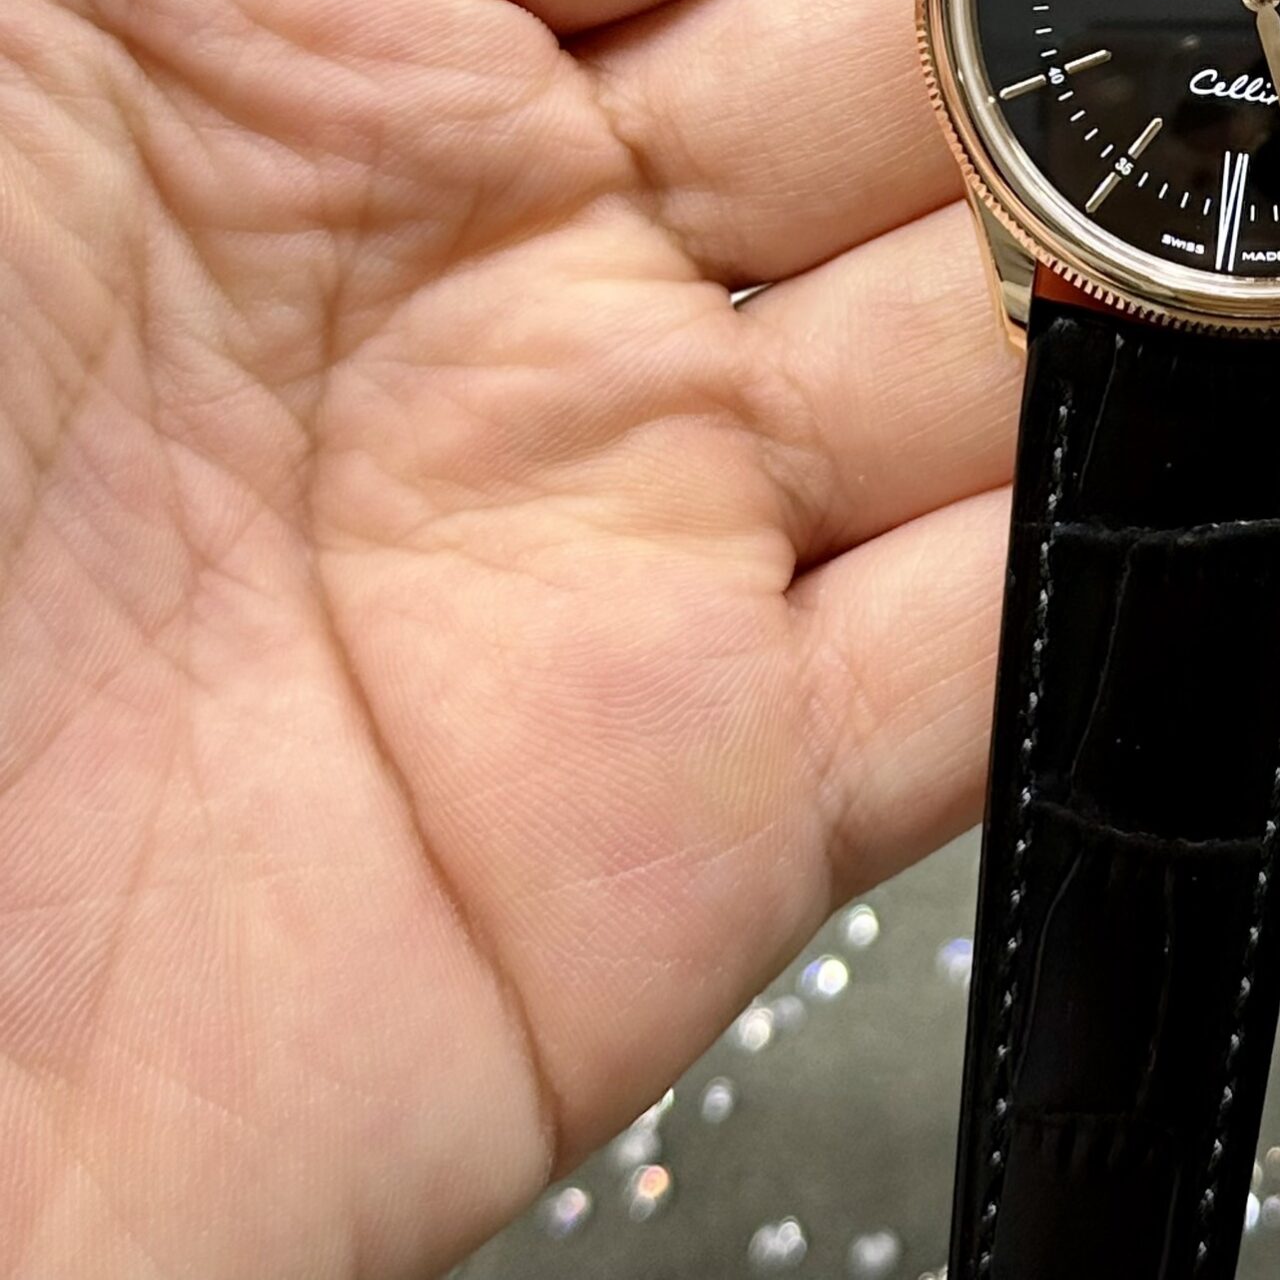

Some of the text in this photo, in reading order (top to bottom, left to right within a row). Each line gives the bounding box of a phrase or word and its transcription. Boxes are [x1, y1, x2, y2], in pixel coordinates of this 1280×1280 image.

[1048, 67, 1065, 85] 40
[1114, 157, 1134, 176] 35
[1161, 233, 1205, 255] SWISS
